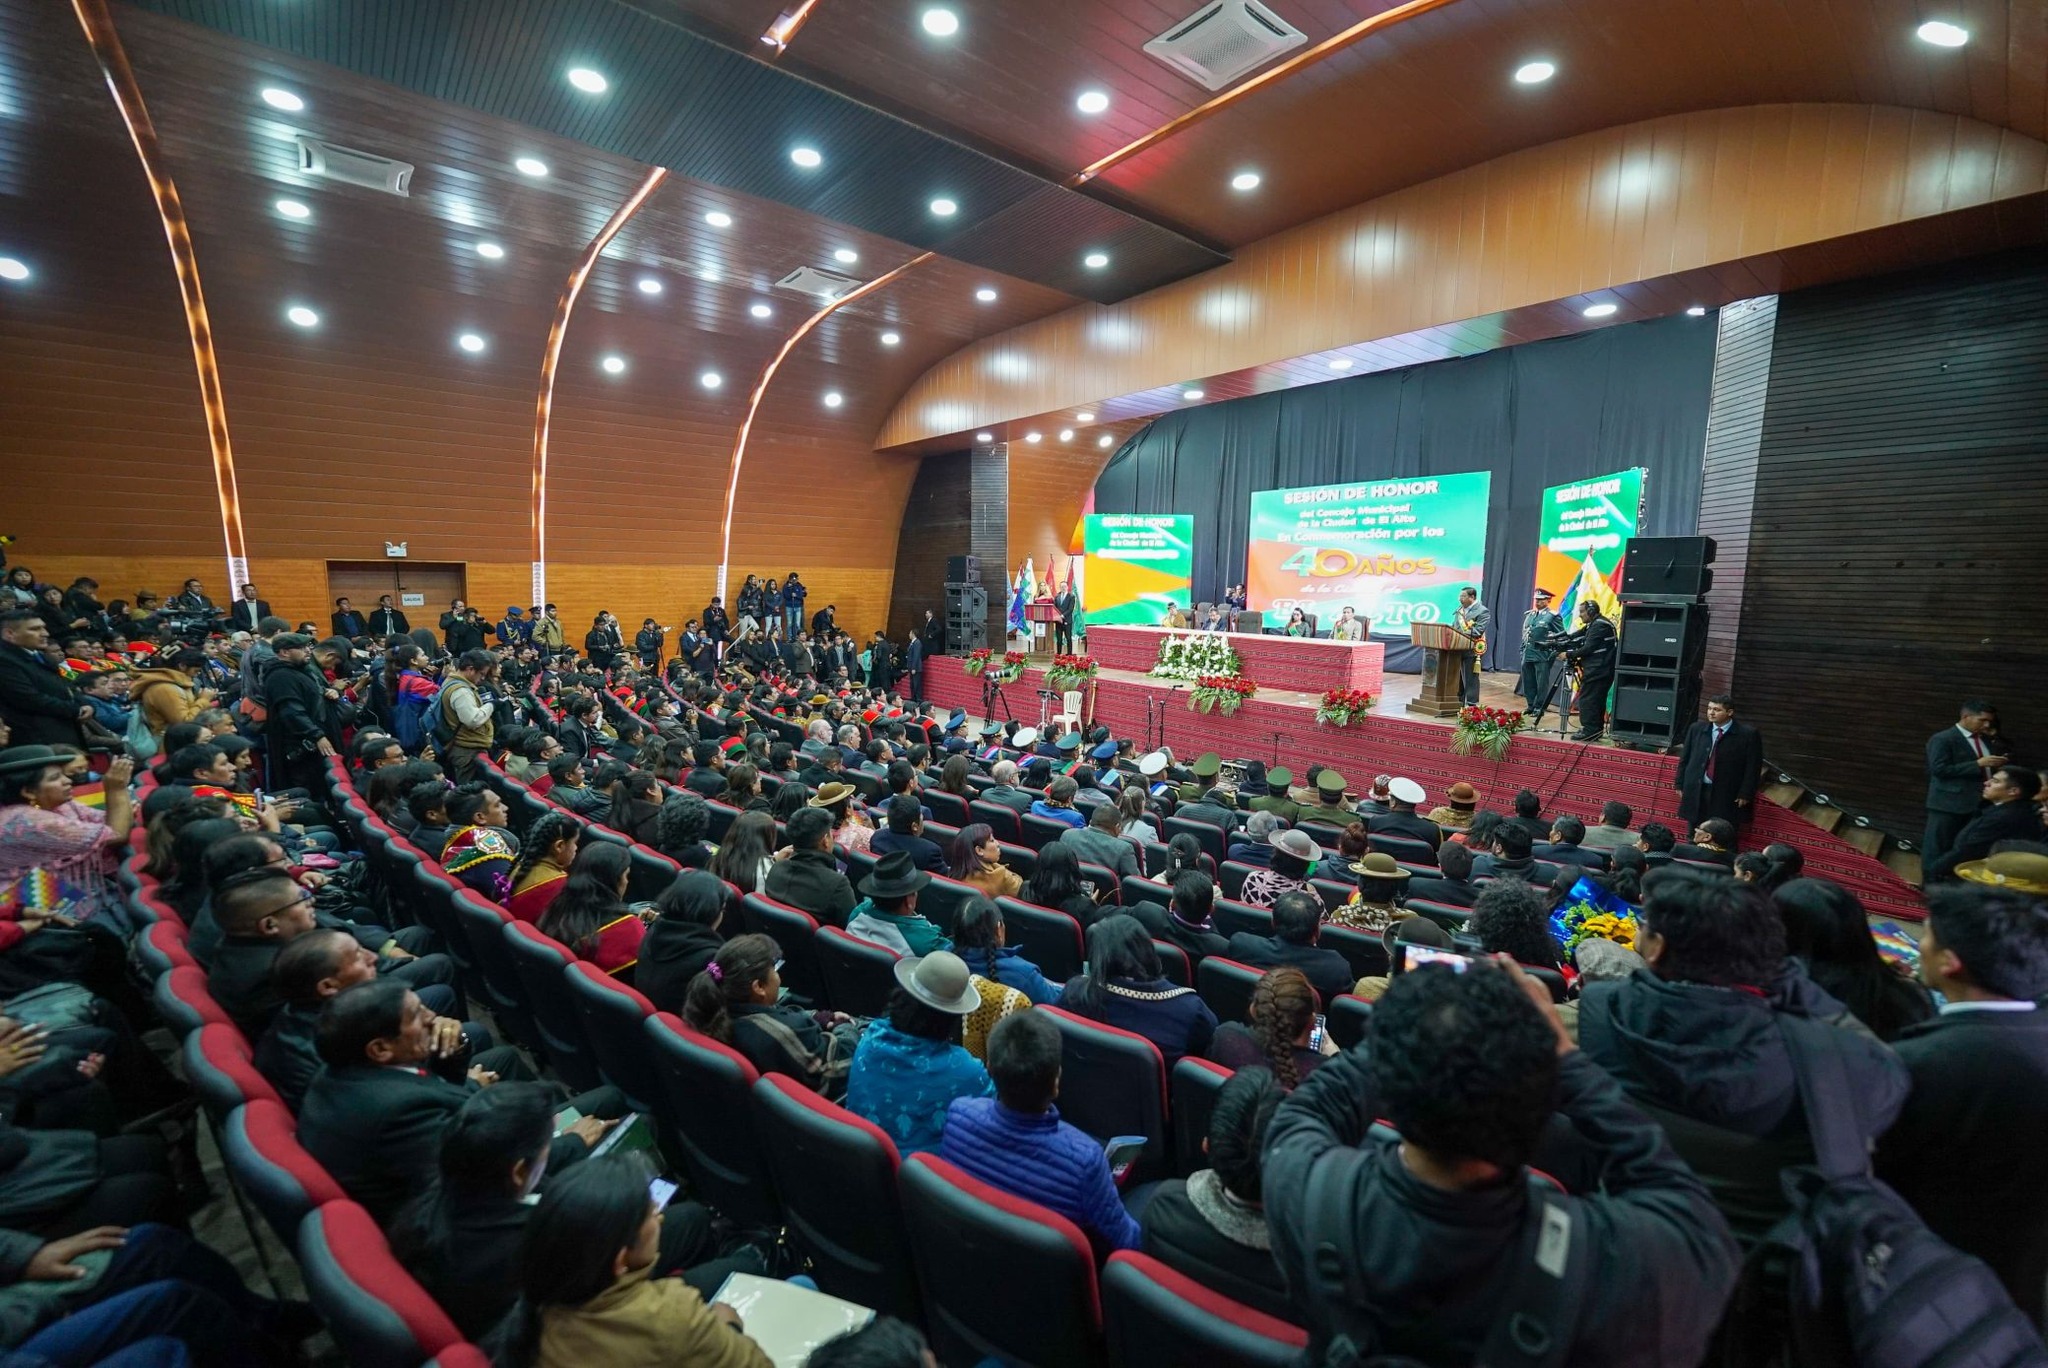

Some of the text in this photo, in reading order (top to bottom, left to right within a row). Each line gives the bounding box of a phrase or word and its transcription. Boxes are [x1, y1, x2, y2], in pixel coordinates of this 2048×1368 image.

[1284, 480, 1440, 505] SESIÓN DE HONOR
[1299, 503, 1411, 519] del Concejo Municipal
[1322, 515, 1357, 527] Ciudad
[1362, 515, 1376, 525] de
[1379, 515, 1390, 525] El
[1392, 513, 1417, 524] Alto
[1394, 527, 1419, 540] por
[1422, 525, 1445, 538] los
[1281, 546, 1437, 578] 40 AÑOS
